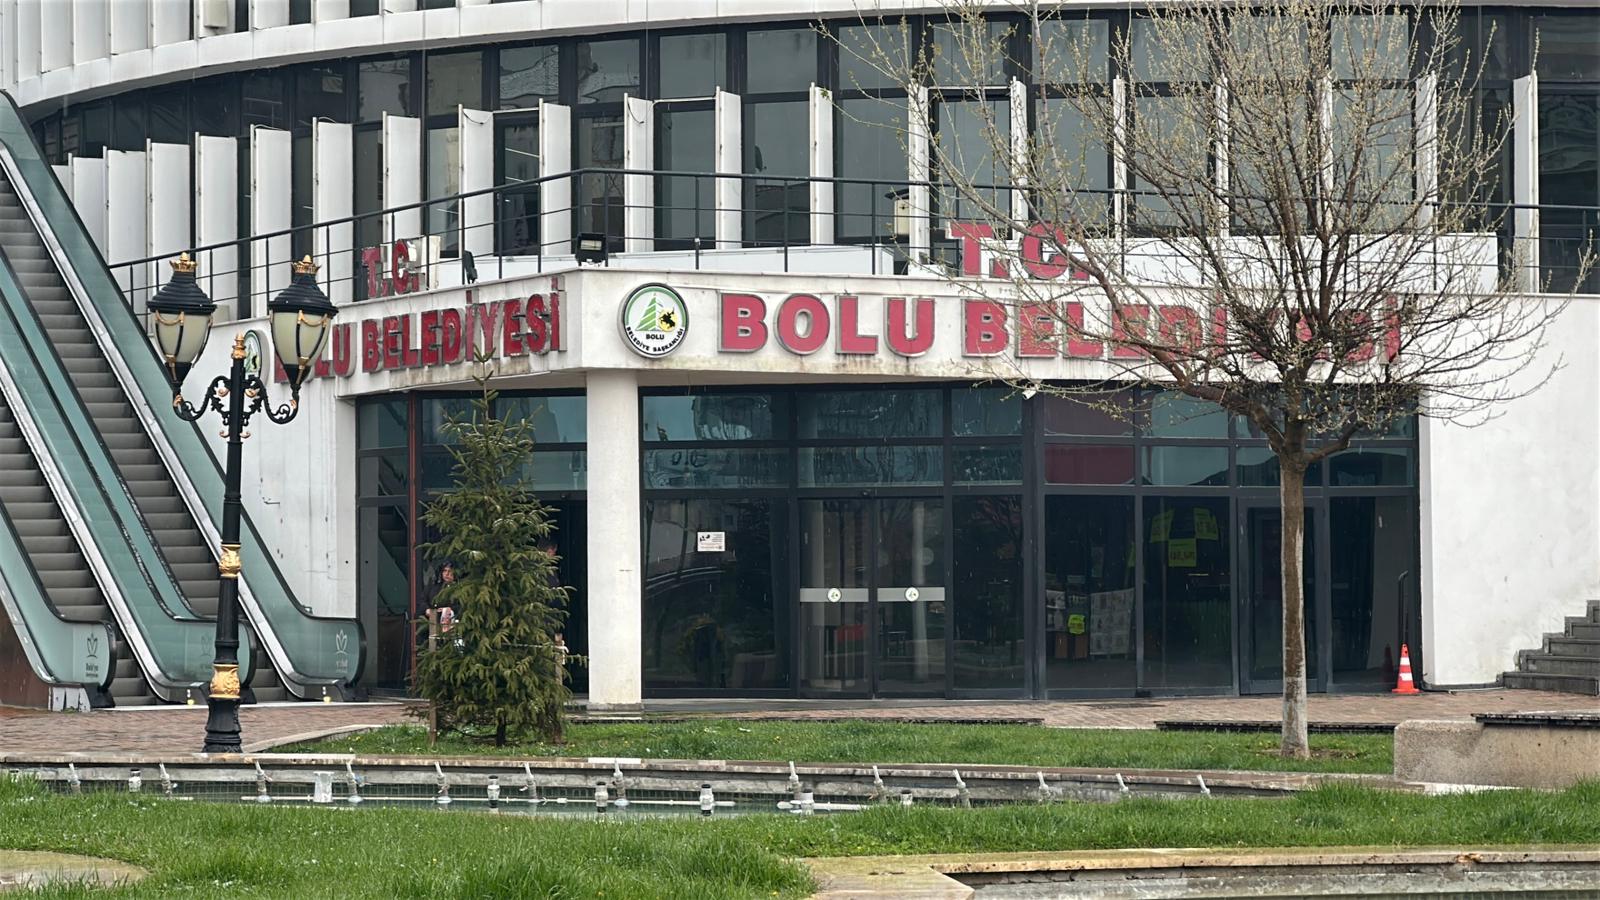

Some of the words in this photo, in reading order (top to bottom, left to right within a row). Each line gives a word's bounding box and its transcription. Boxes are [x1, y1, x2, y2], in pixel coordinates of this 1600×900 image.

[361, 239, 420, 298] T.C.
[947, 221, 1090, 281] T.C.
[361, 276, 566, 374] BELEDİYESİ
[626, 326, 650, 351] BELEDİYE
[718, 289, 936, 358] BOLU
